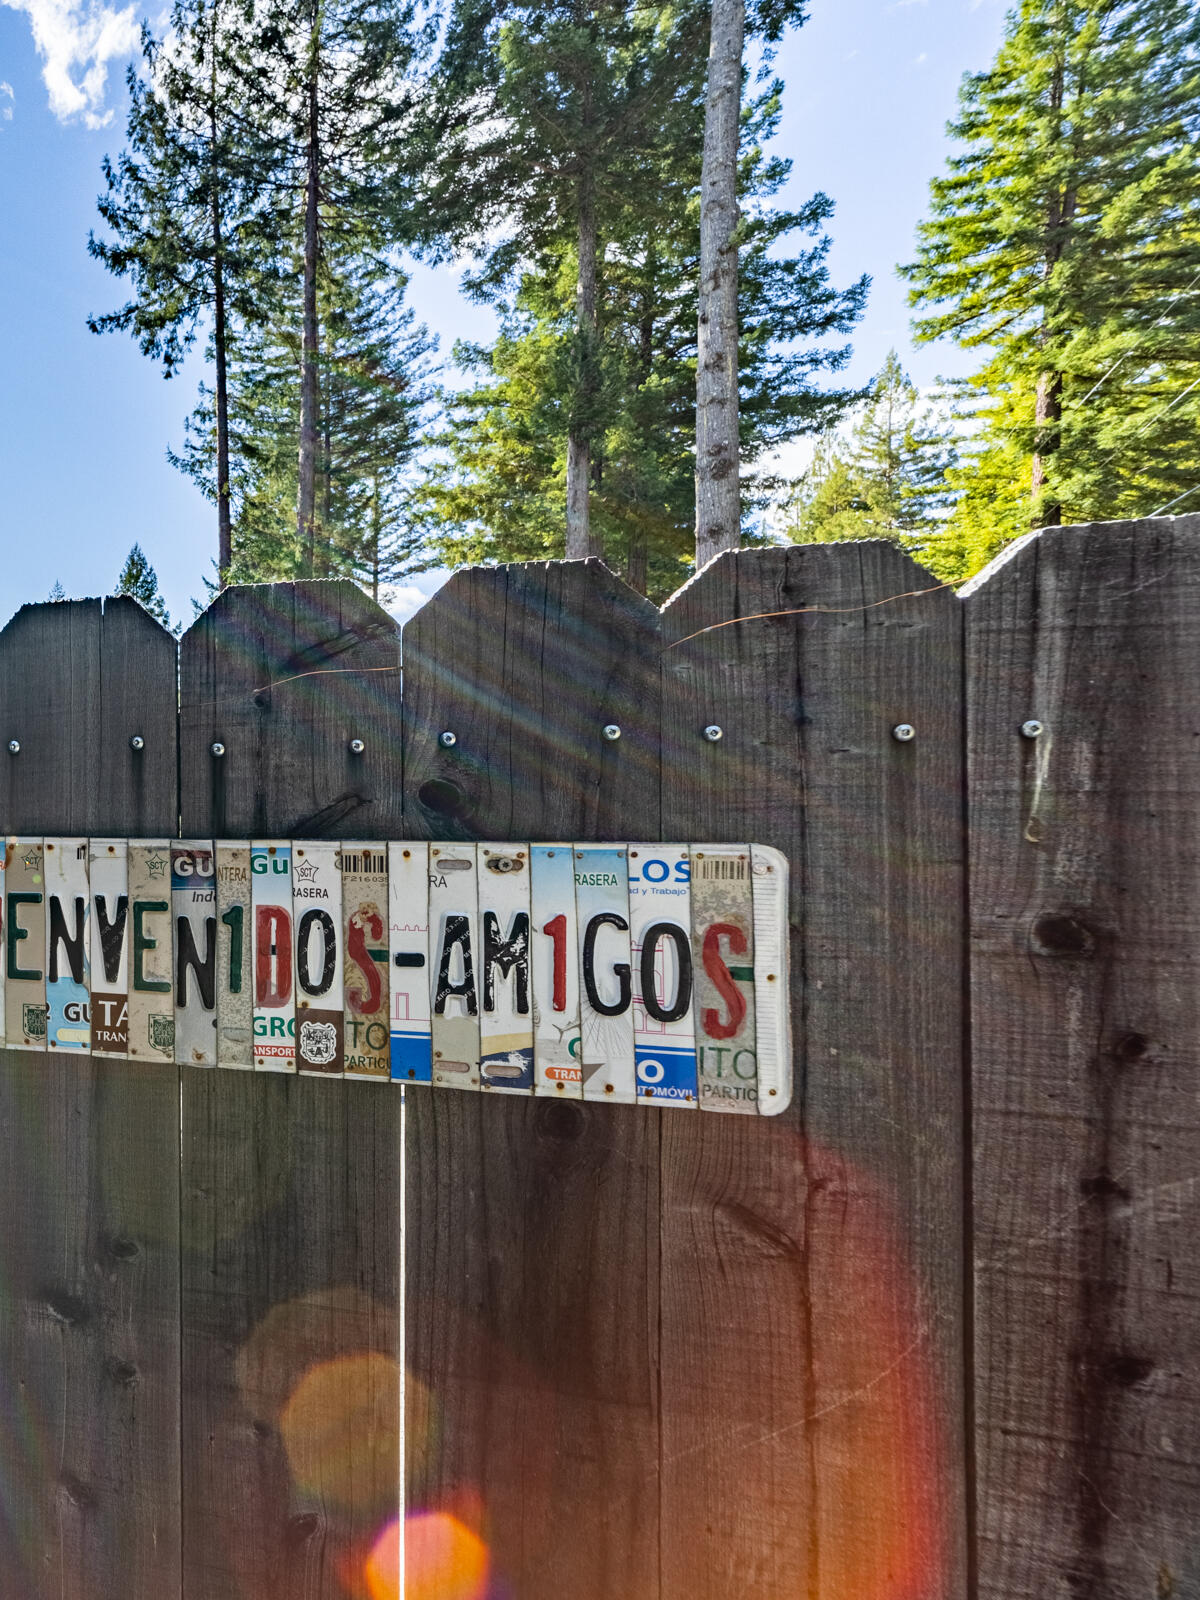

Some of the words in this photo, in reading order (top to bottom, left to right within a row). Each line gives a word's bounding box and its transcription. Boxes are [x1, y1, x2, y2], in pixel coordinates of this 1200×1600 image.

[150, 861, 163, 870] SCT
[174, 855, 215, 877] GU
[251, 854, 288, 875] Gu
[299, 867, 313, 878] SCT
[429, 875, 448, 888] RA
[574, 873, 618, 886] RASERA
